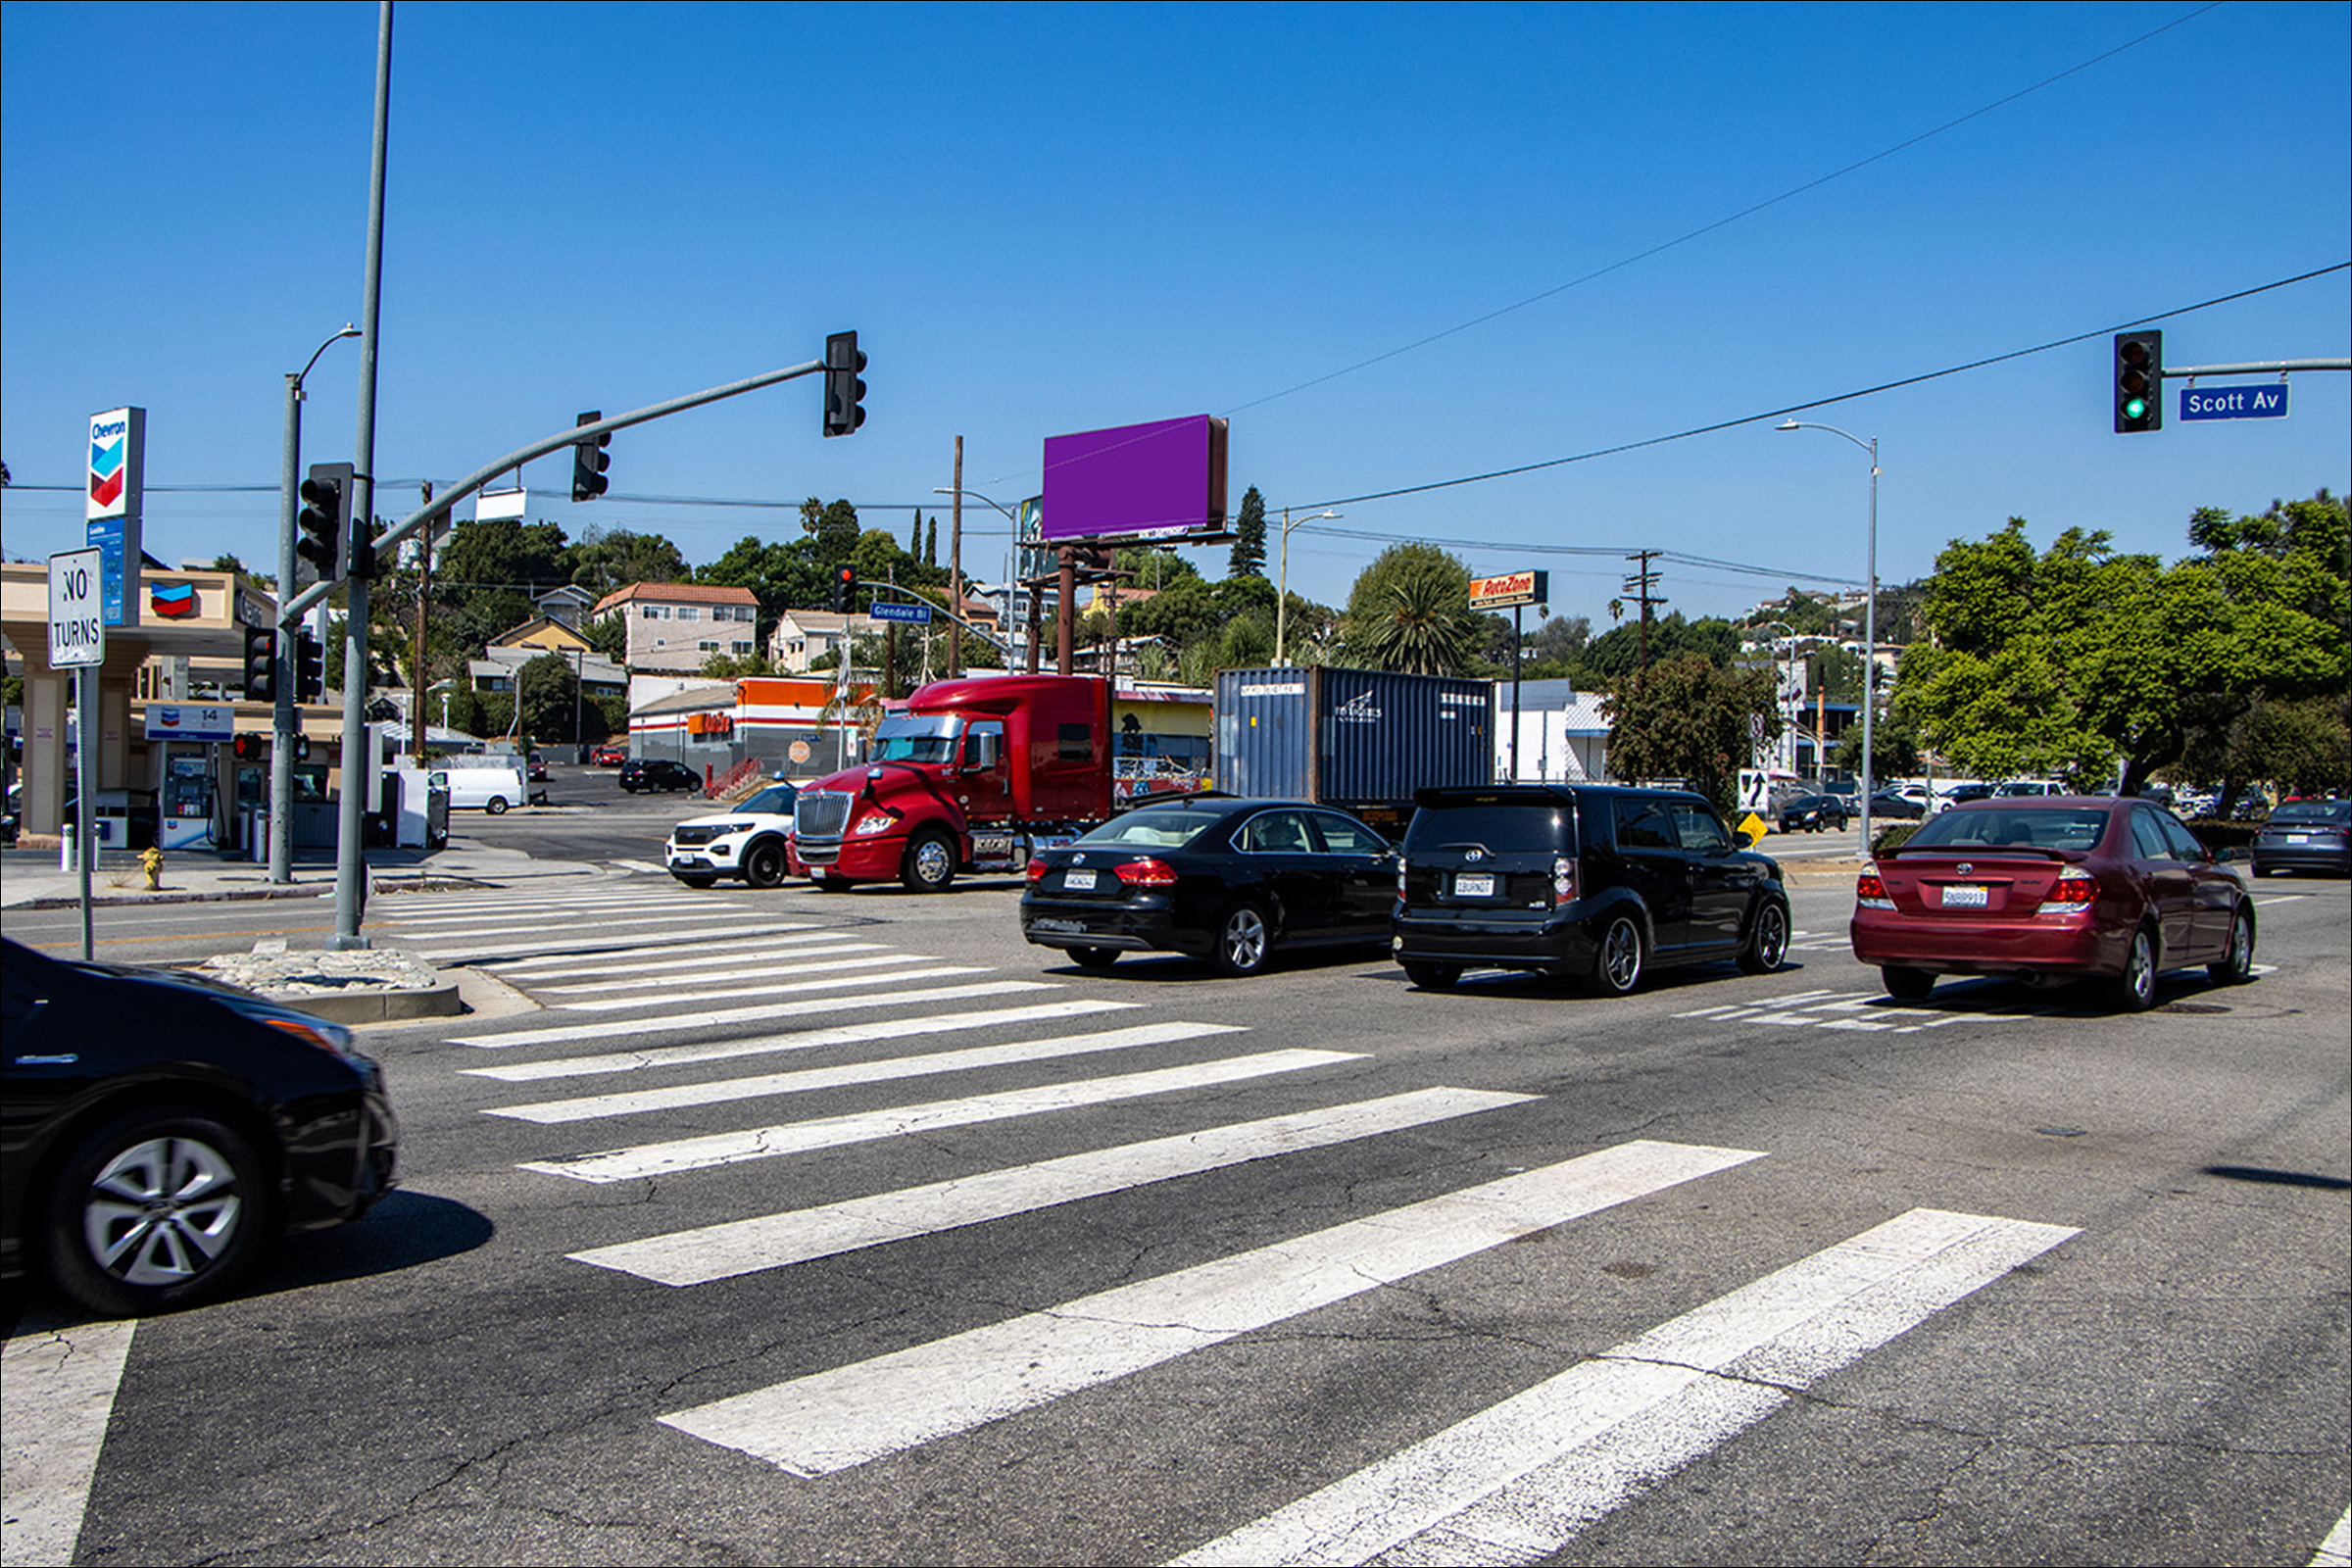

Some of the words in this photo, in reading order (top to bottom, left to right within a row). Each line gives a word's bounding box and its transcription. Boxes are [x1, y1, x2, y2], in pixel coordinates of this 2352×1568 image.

[2188, 393, 2245, 413] Scott
[2253, 390, 2279, 410] Av
[91, 420, 126, 440] Chevron
[63, 567, 88, 603] NO
[1483, 575, 1532, 596] AutoZone
[874, 605, 915, 619] Glendale
[916, 608, 928, 619] Bl
[53, 616, 100, 649] TURNS
[201, 709, 219, 721] 14
